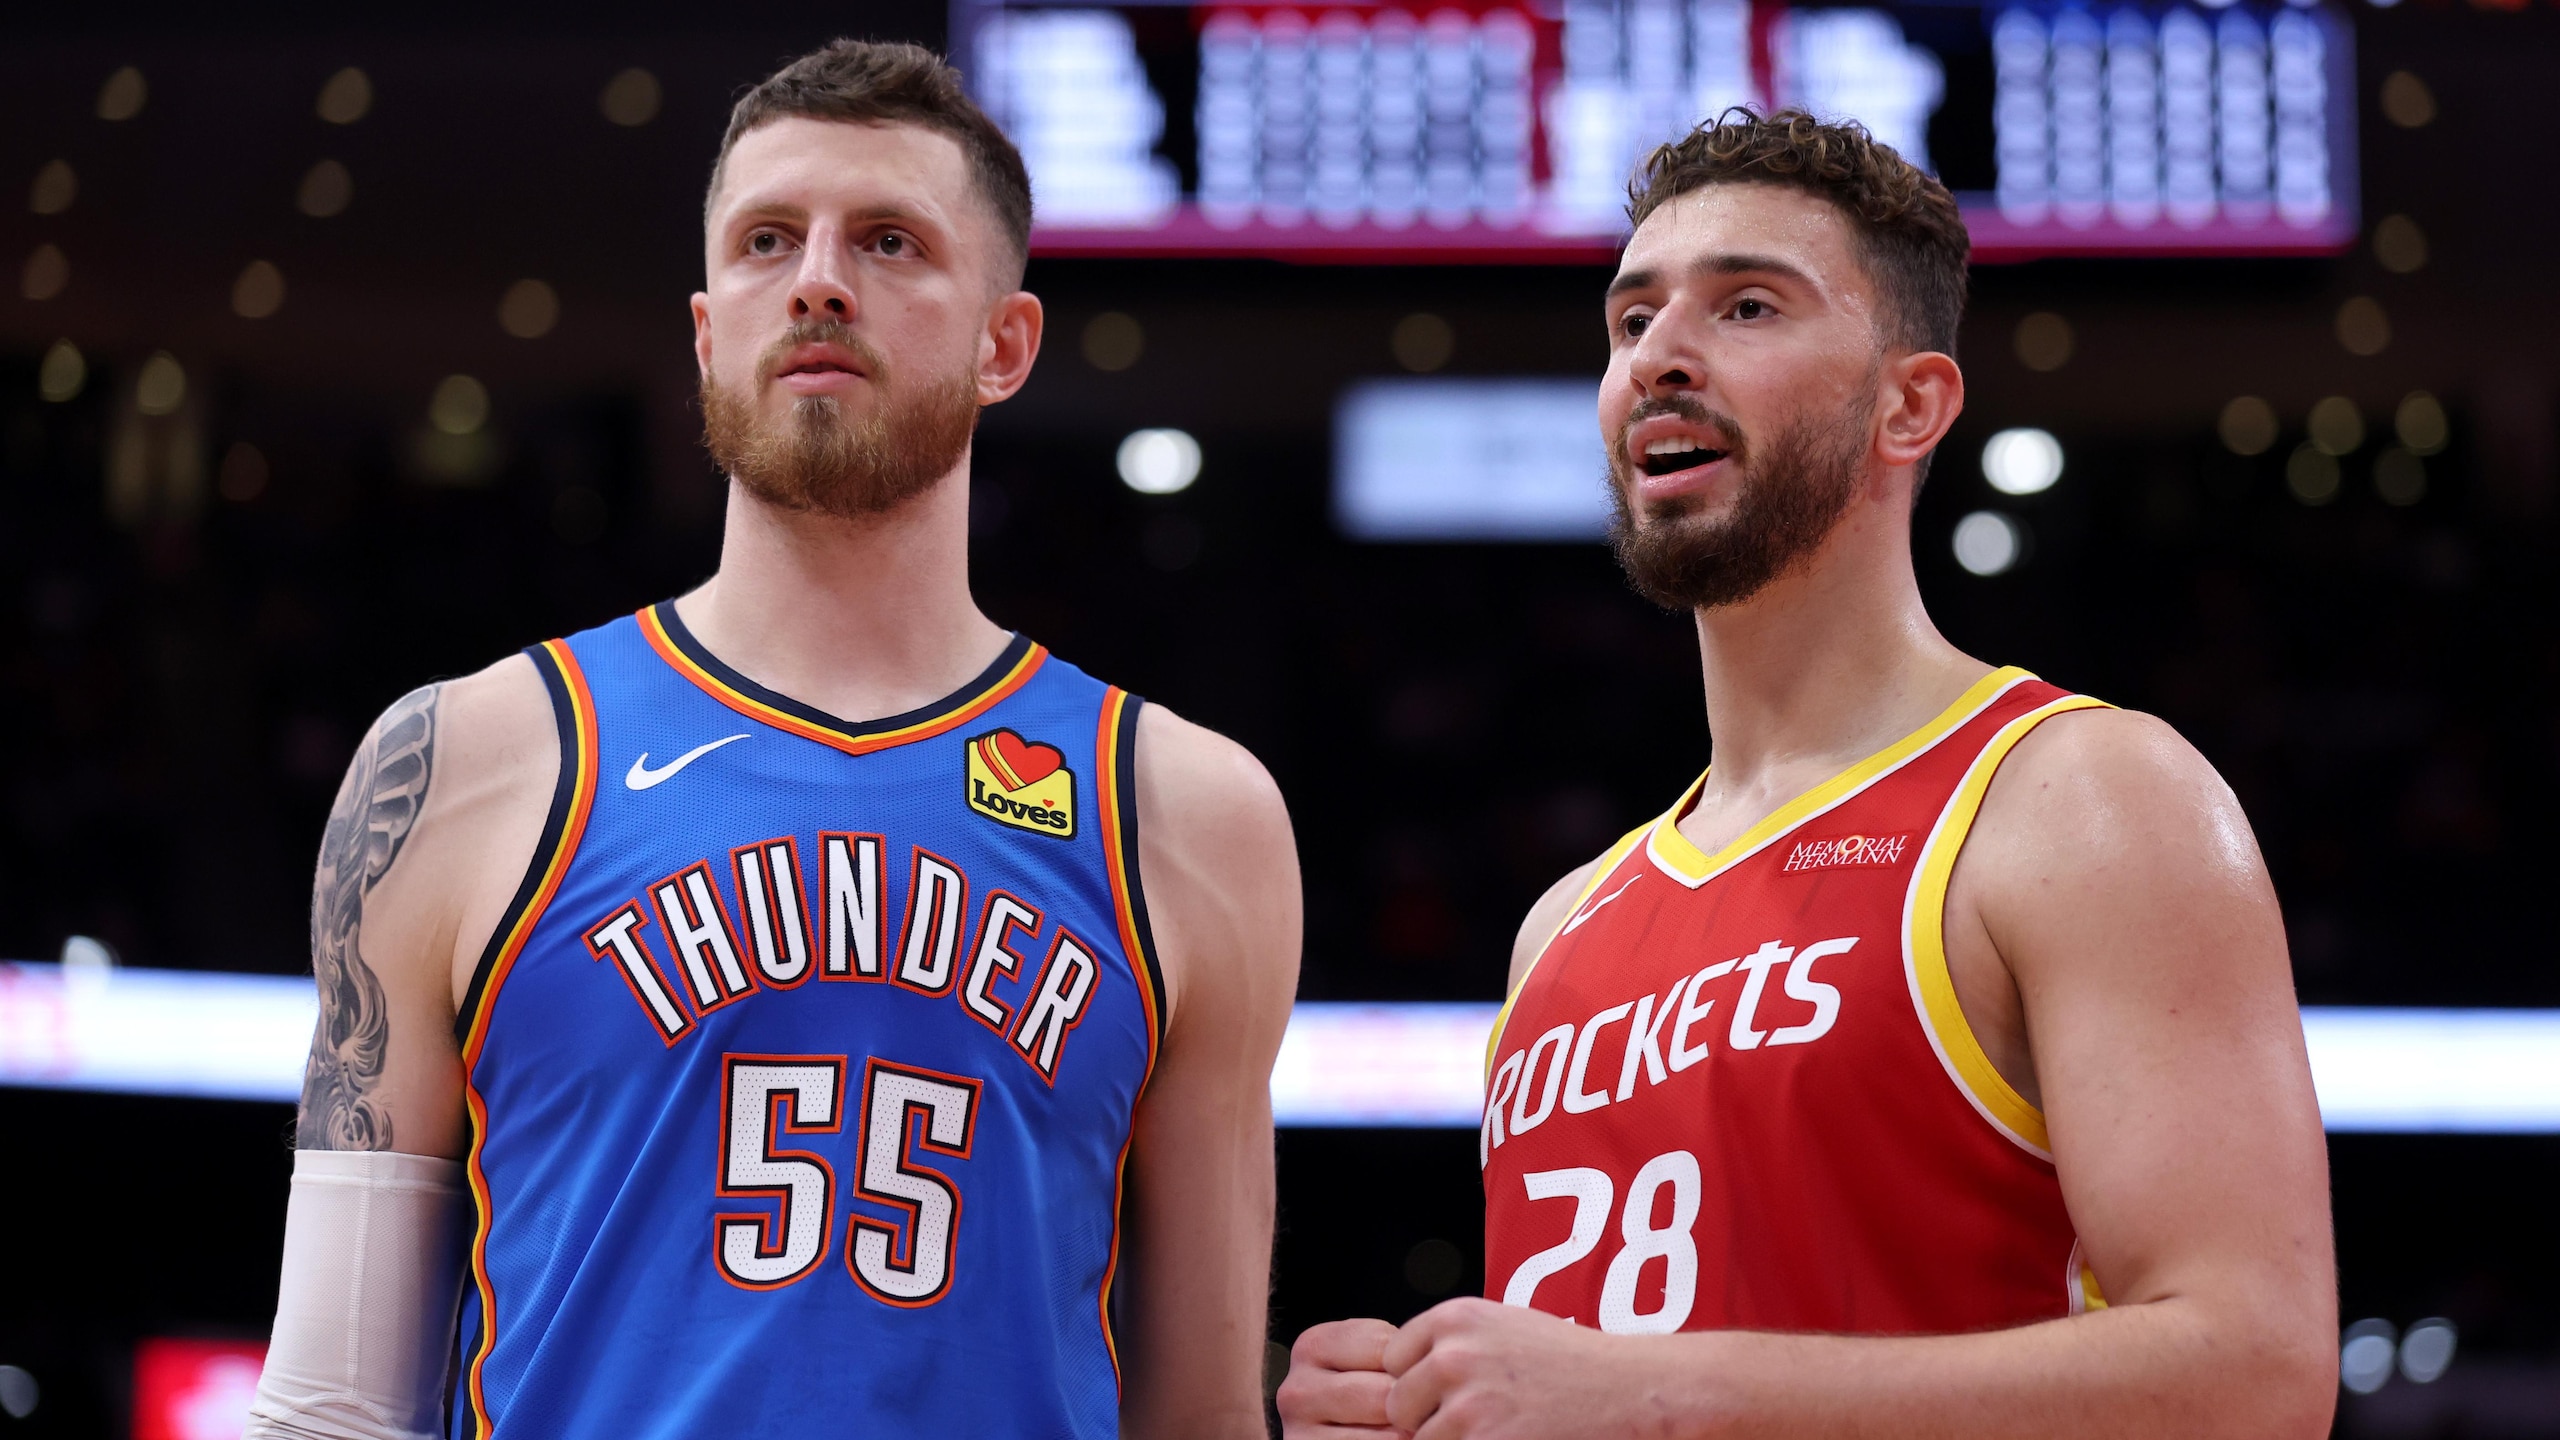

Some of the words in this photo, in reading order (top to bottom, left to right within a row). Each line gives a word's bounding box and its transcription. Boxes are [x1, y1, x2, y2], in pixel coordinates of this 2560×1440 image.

[1783, 849, 1904, 871] HERMANN
[1790, 835, 1908, 857] MEMORIAL
[581, 831, 1100, 1089] THUNDER
[713, 1053, 984, 1308] 55
[1502, 1150, 1702, 1335] 28
